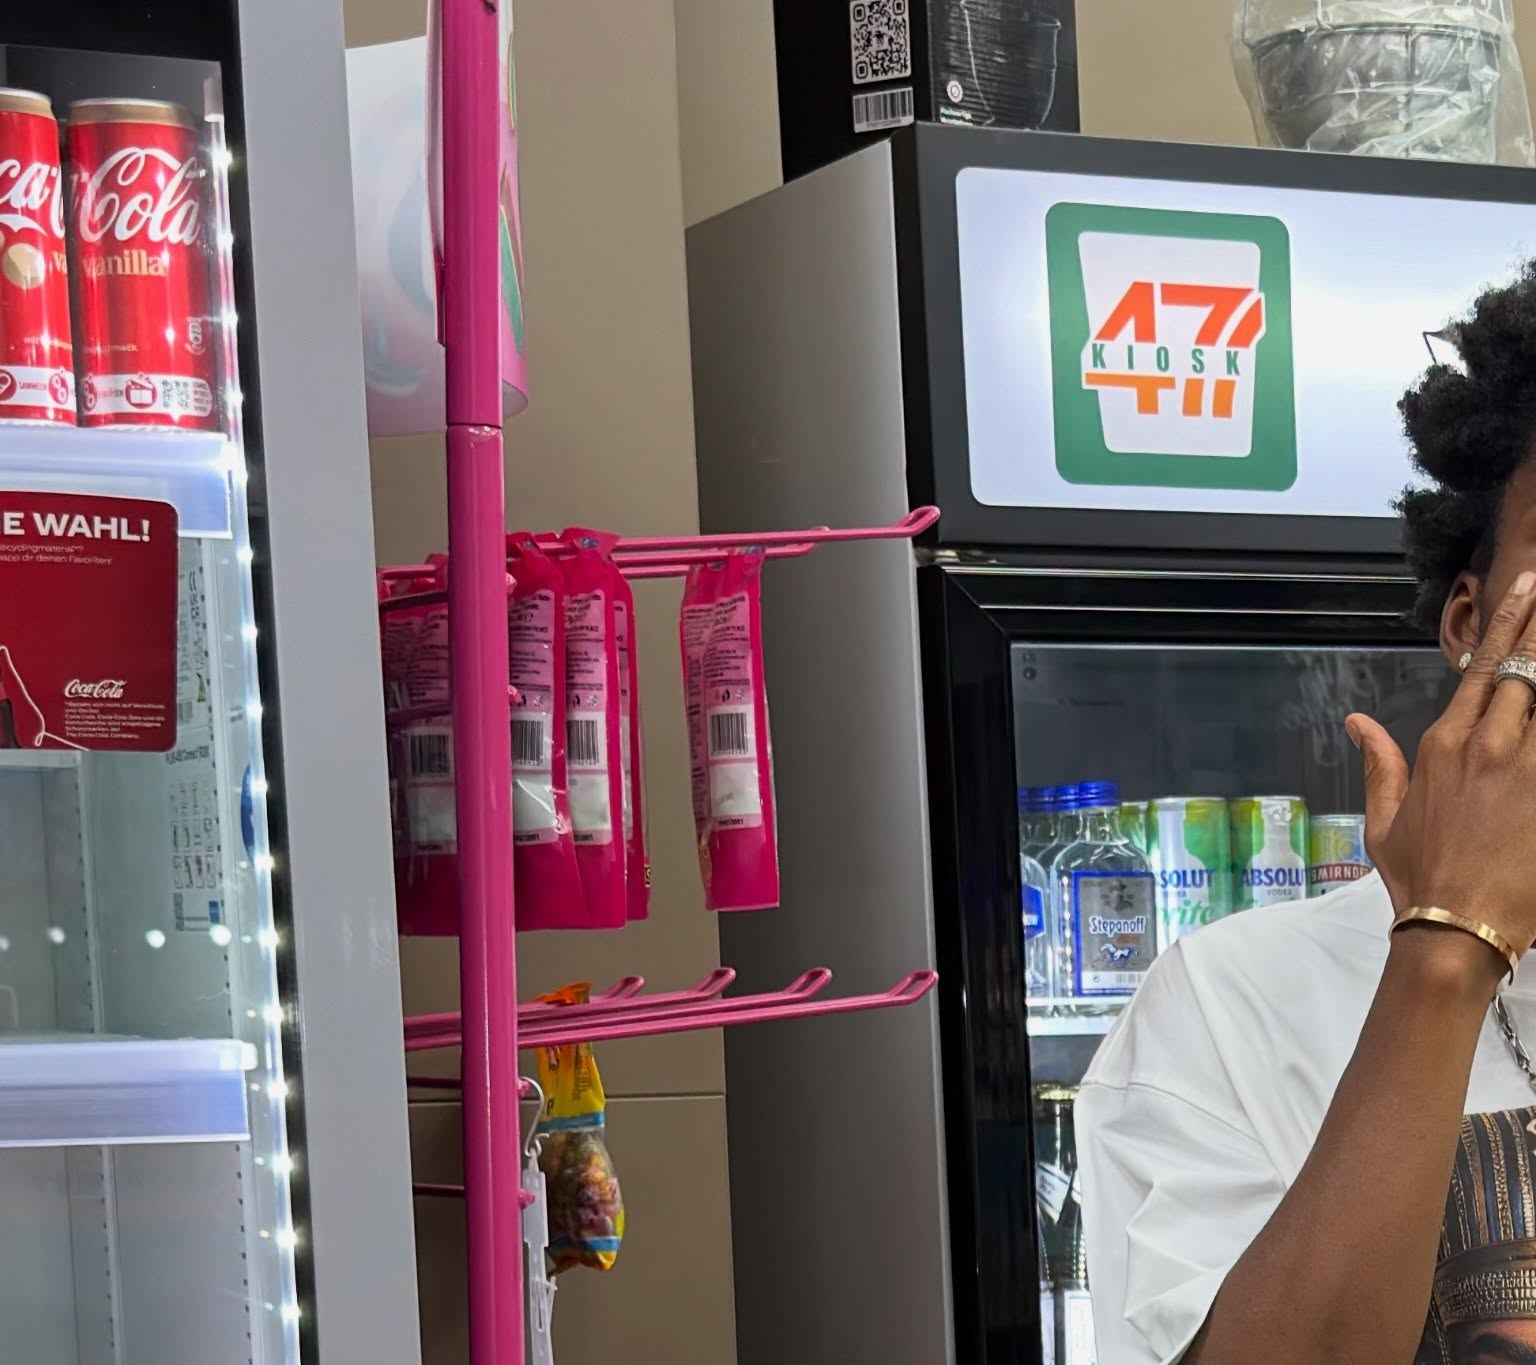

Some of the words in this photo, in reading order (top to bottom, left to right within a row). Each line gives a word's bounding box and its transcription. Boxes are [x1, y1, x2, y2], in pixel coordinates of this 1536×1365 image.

[82, 249, 165, 277] vanilla
[1092, 342, 1241, 376] KIOSK
[33, 513, 150, 542] WAHL!
[1160, 869, 1215, 888] SOLUT
[1089, 915, 1147, 935] Stepanoff
